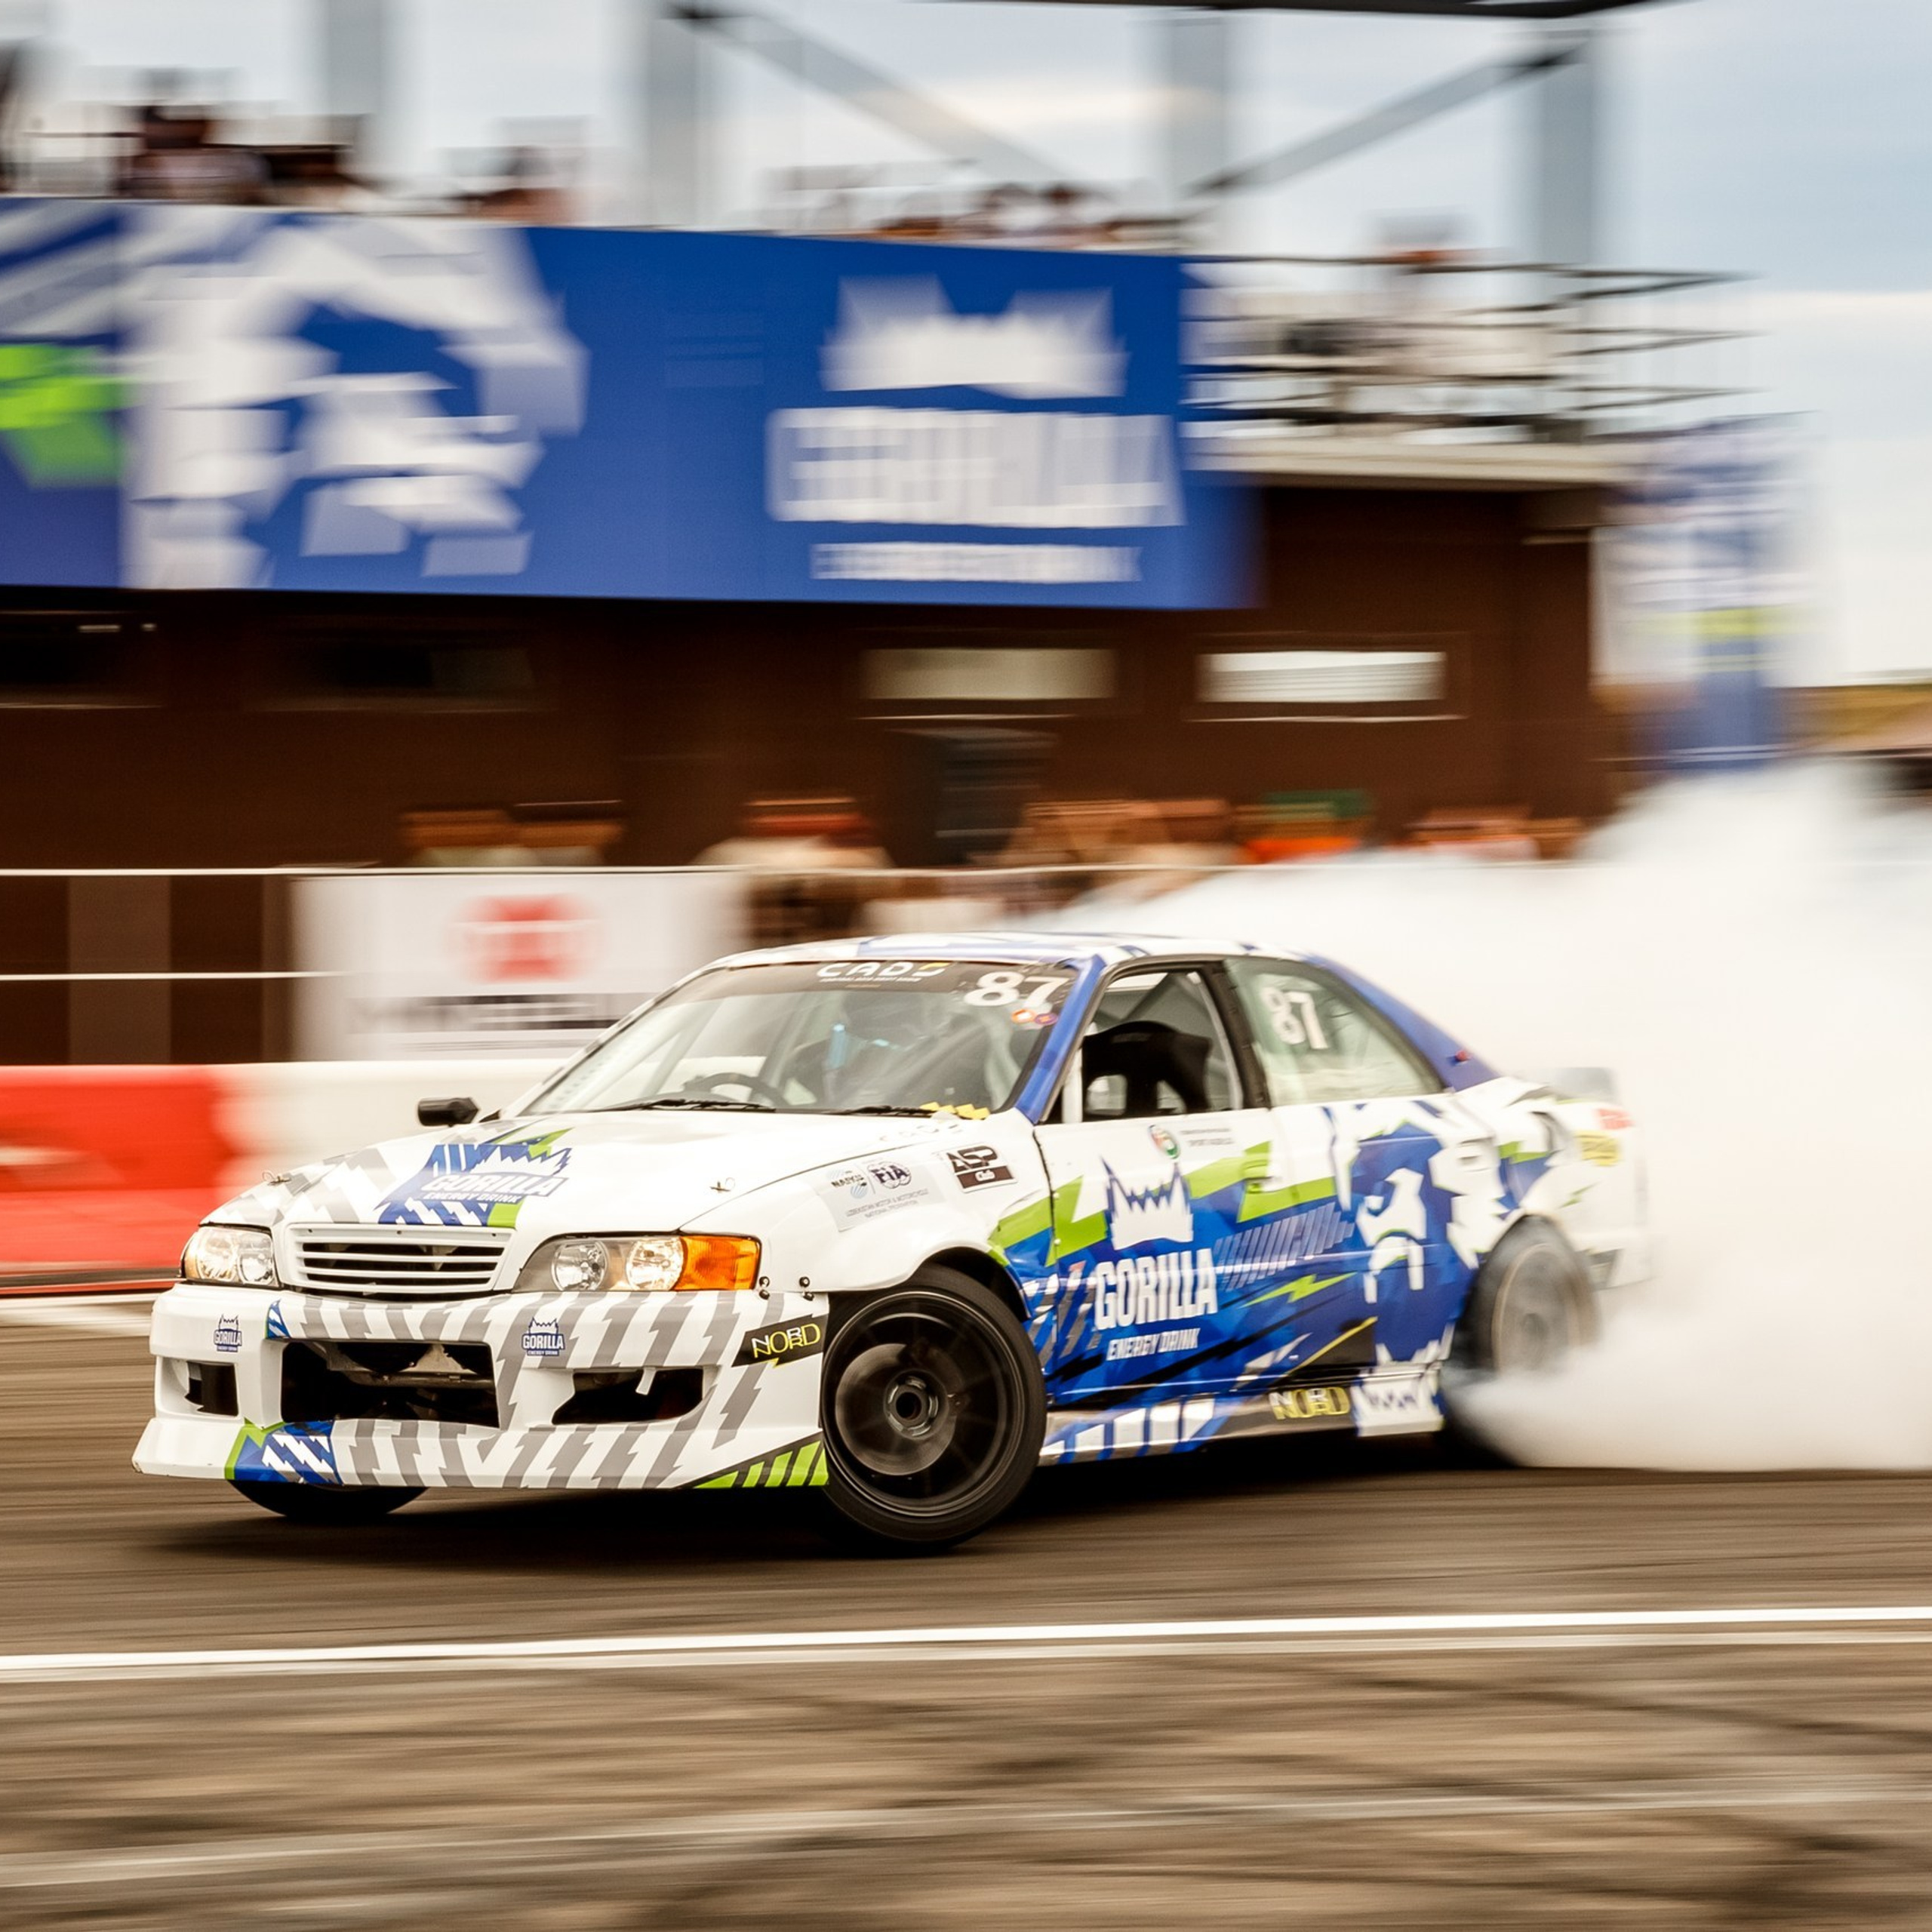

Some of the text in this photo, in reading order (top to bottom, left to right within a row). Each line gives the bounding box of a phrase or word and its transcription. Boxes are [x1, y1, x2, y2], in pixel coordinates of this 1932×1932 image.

[964, 971, 1070, 1008] 87
[1260, 986, 1329, 1050] 87
[420, 1174, 567, 1196] GORILLA
[870, 1164, 909, 1184] FIA
[1094, 1248, 1218, 1331] GORILLA
[523, 1334, 565, 1349] GORILLA
[751, 1323, 821, 1358] NORD
[1106, 1334, 1161, 1361] ENERGY
[1269, 1386, 1350, 1420] NORD
